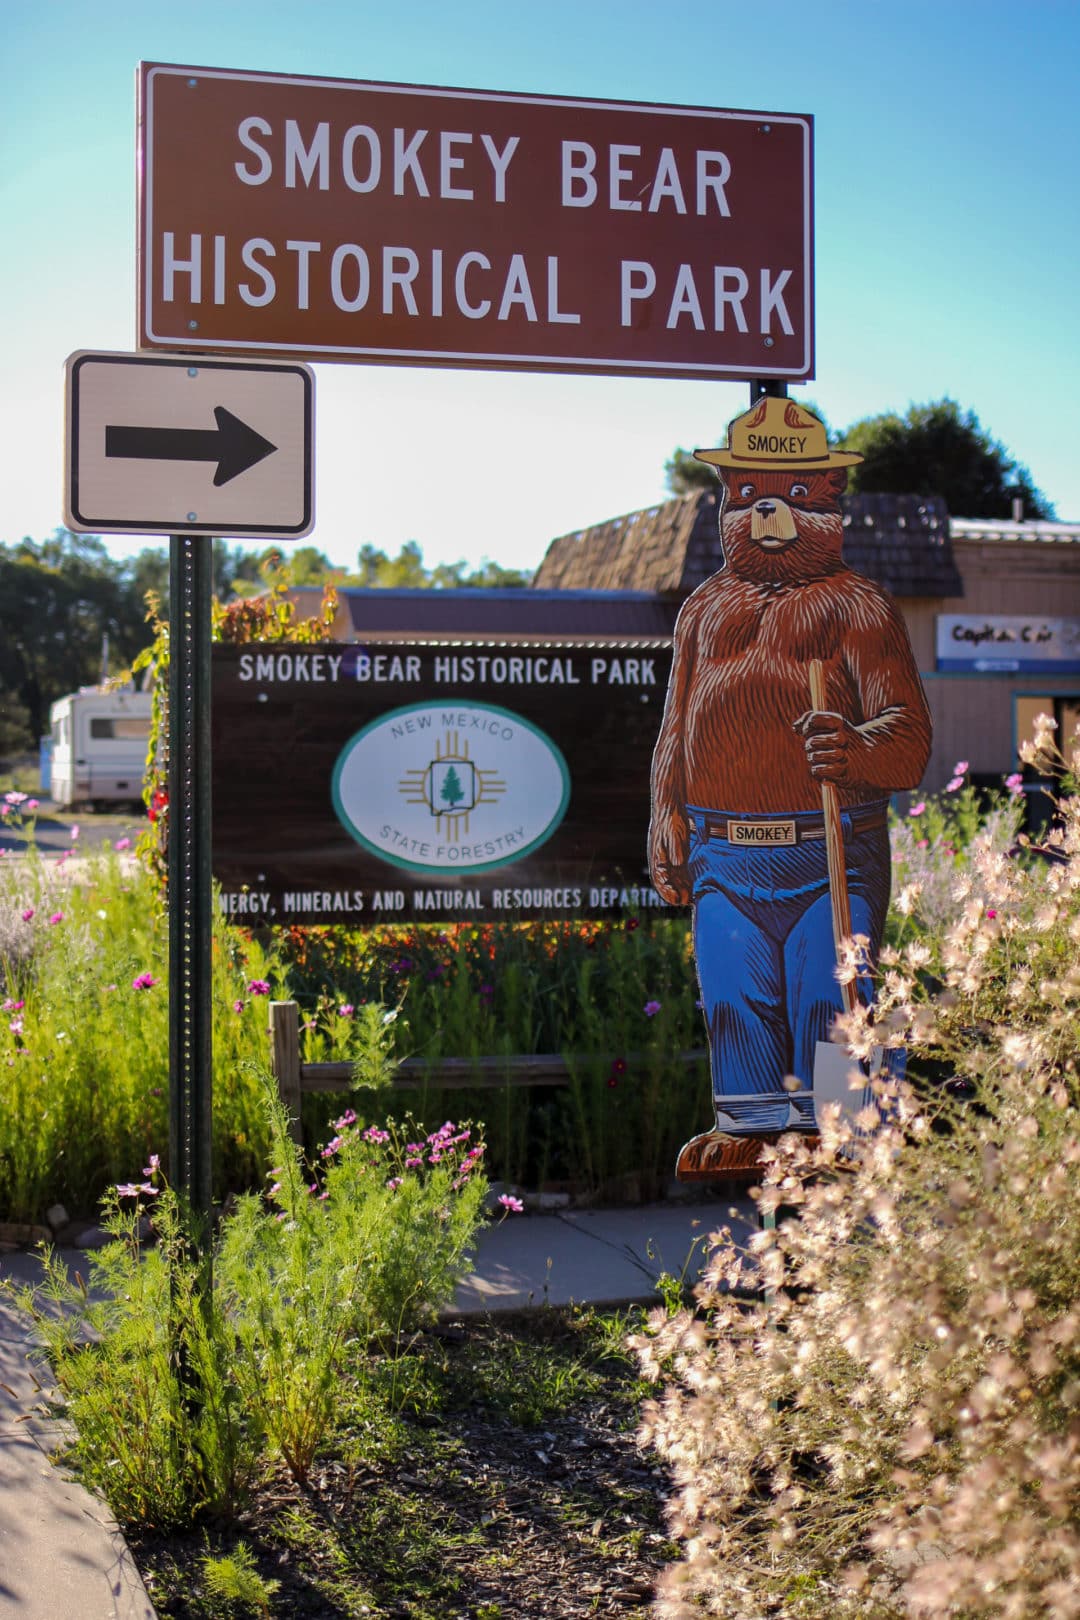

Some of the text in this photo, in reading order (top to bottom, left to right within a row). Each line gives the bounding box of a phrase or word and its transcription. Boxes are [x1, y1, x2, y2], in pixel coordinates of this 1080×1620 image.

[234, 116, 732, 217] SMOKEY BEAR
[162, 231, 795, 336] HISTORICAL PARK
[747, 434, 808, 453] SMOKEY
[239, 654, 656, 685] SMOKEY BEAR HISTORICAL PARK
[391, 713, 514, 741] NEW MEXICO
[380, 825, 526, 861] STATE FORESTRY
[736, 826, 791, 841] SMOKEY
[217, 892, 276, 916] NERGY,
[284, 891, 364, 913] MINERALS
[372, 891, 405, 911] AND
[414, 889, 484, 910] NATURAL
[492, 888, 582, 909] RESOURCES
